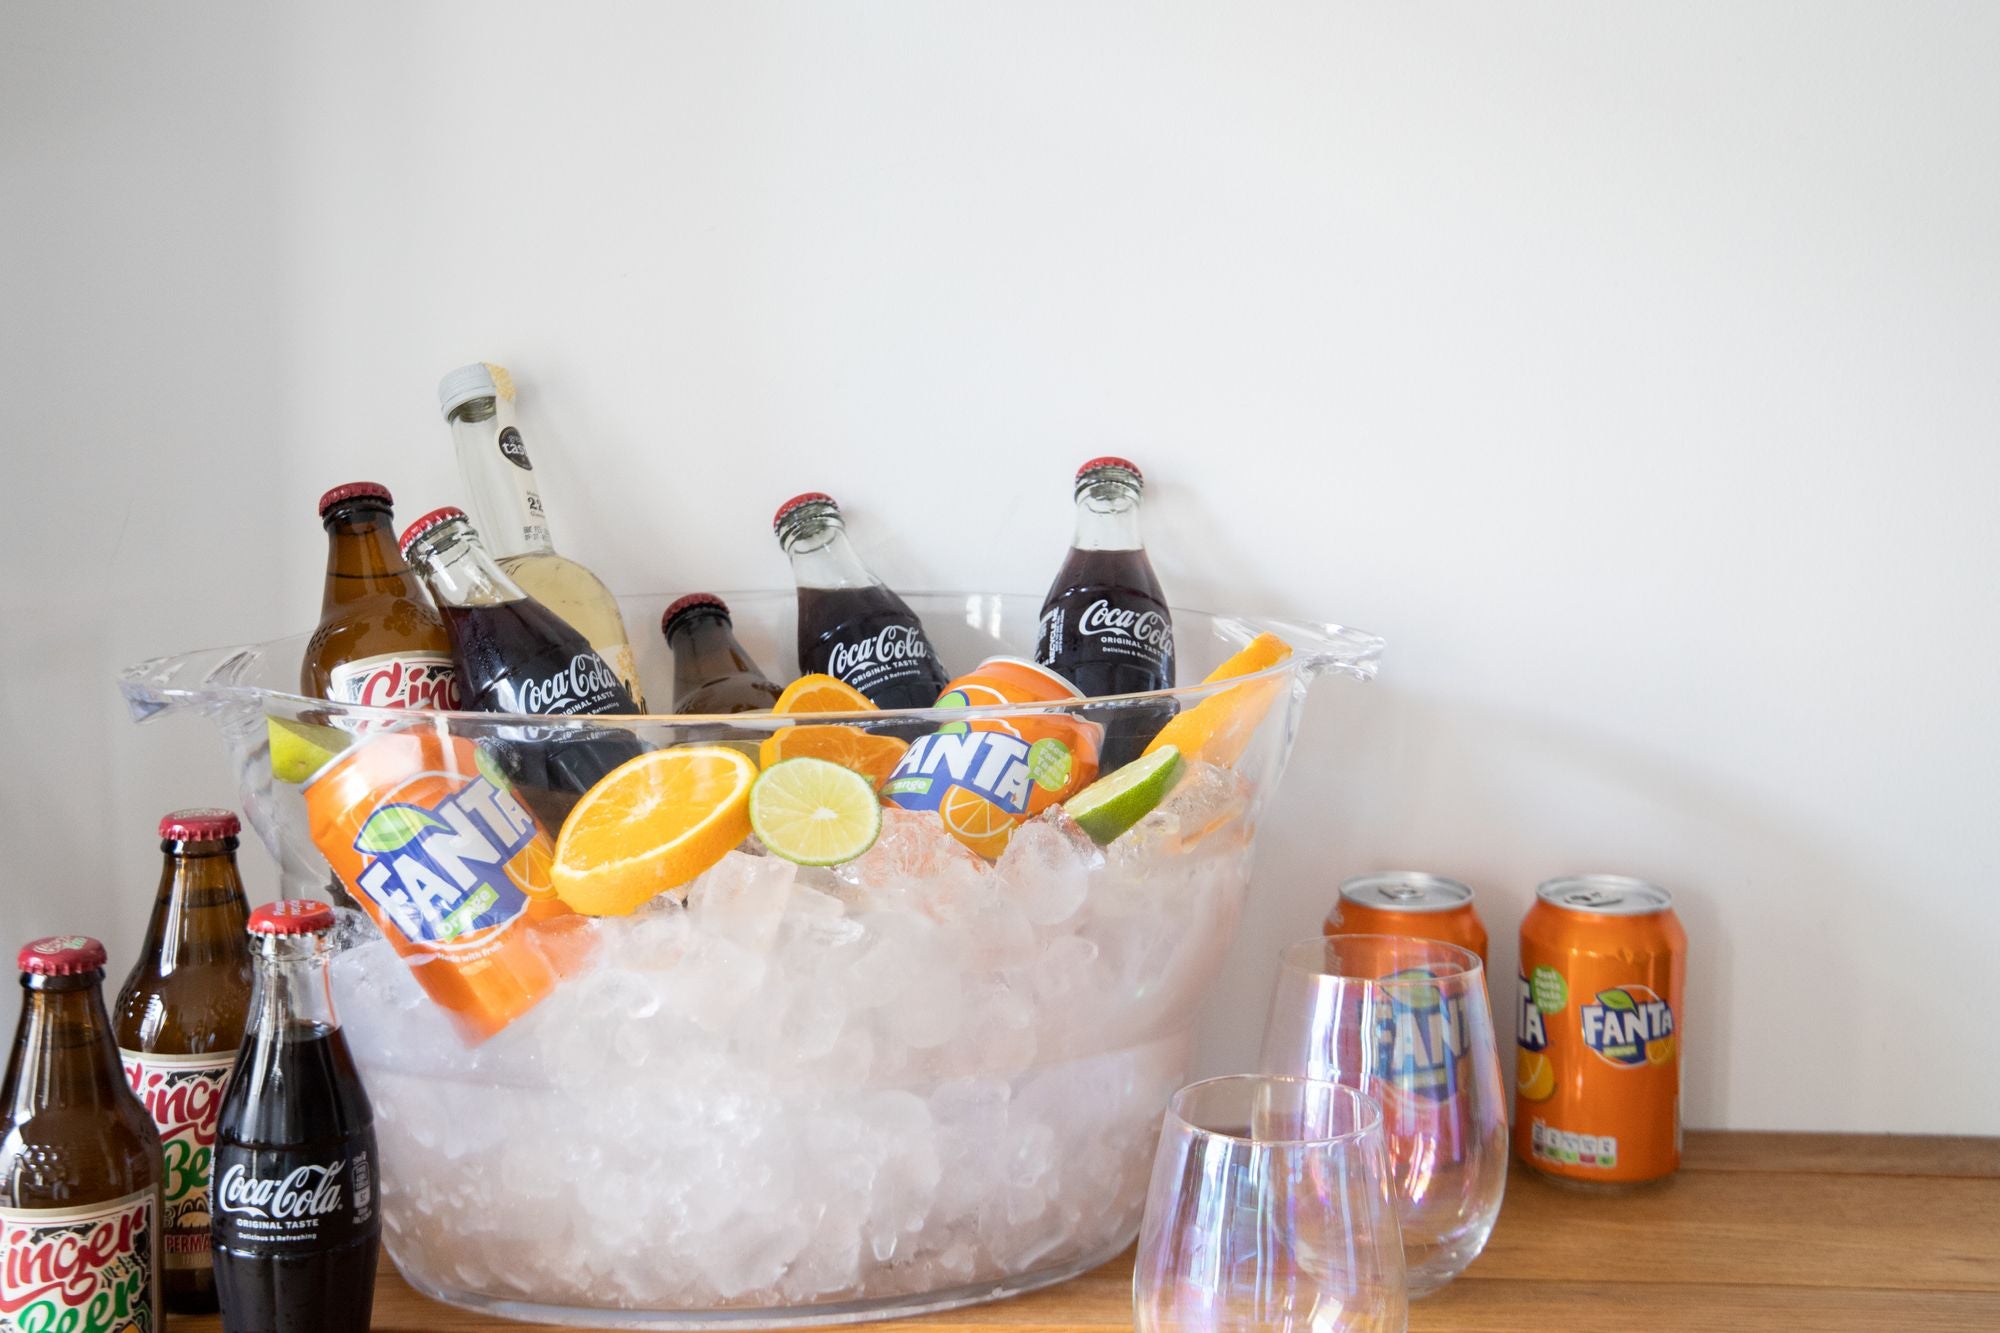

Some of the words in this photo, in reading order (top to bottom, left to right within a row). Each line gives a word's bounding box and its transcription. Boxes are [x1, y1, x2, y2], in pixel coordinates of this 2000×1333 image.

[1078, 599, 1173, 657] Coca-Cola
[1101, 636, 1142, 649] ORIGINAL
[828, 625, 927, 682] Coca-Cola
[1102, 646, 1131, 655] Delicious
[519, 653, 617, 715] Coca-Cola
[852, 664, 892, 685] ORIGINAL
[892, 659, 919, 669] TASTE
[857, 677, 884, 692] Delicious
[889, 669, 920, 679] Refreshing
[591, 690, 615, 702] TASTE
[889, 731, 1030, 811] ANTA
[360, 776, 533, 937] FANTA
[1583, 1001, 1673, 1046] FANTA
[219, 1159, 346, 1218] Coca-Cola
[237, 1218, 283, 1229] ORIGINAL
[286, 1218, 320, 1228] TASTE
[238, 1231, 268, 1242] Delicious
[269, 1234, 275, 1242] &
[276, 1232, 317, 1242] Refreshing
